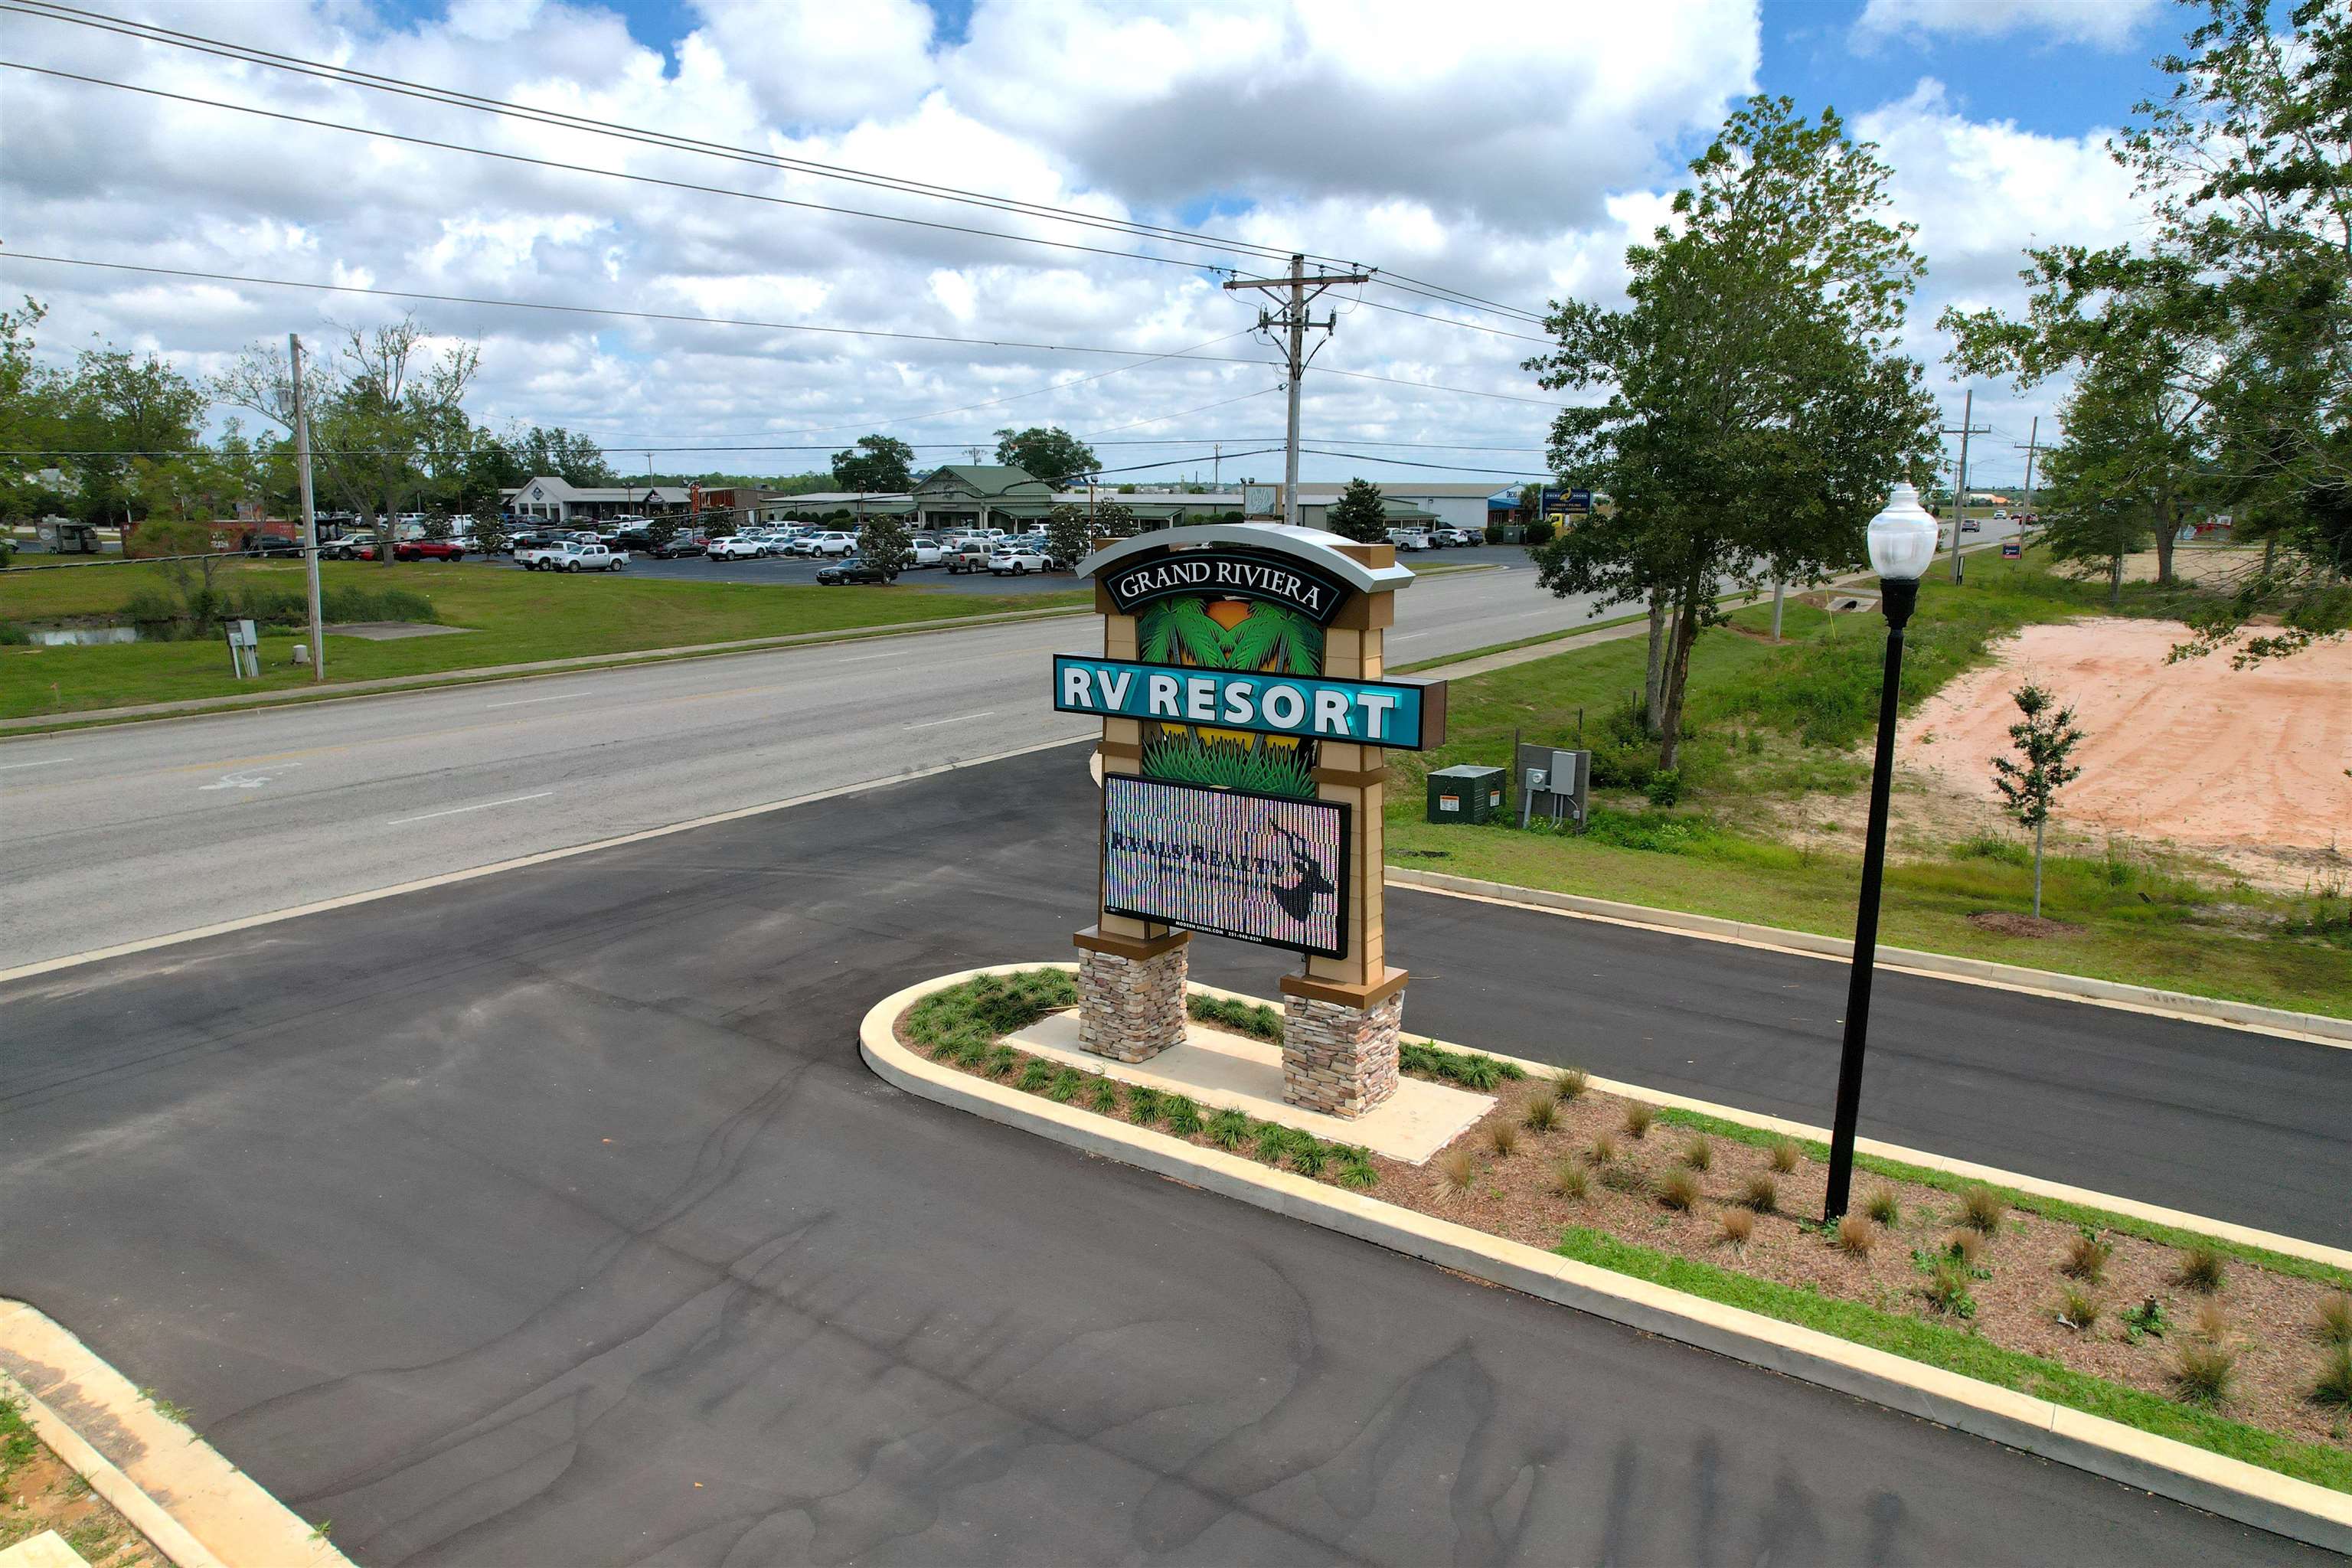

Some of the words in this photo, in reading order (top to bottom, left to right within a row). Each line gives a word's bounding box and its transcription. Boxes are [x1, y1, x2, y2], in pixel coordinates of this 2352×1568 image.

[1120, 562, 1210, 598] GRAND
[1216, 562, 1320, 610] RIVIERA
[1063, 668, 1133, 711] RV
[1149, 675, 1395, 739] RESORT
[1175, 920, 1196, 929] MODERN
[1196, 925, 1223, 934] SIGNS.COM
